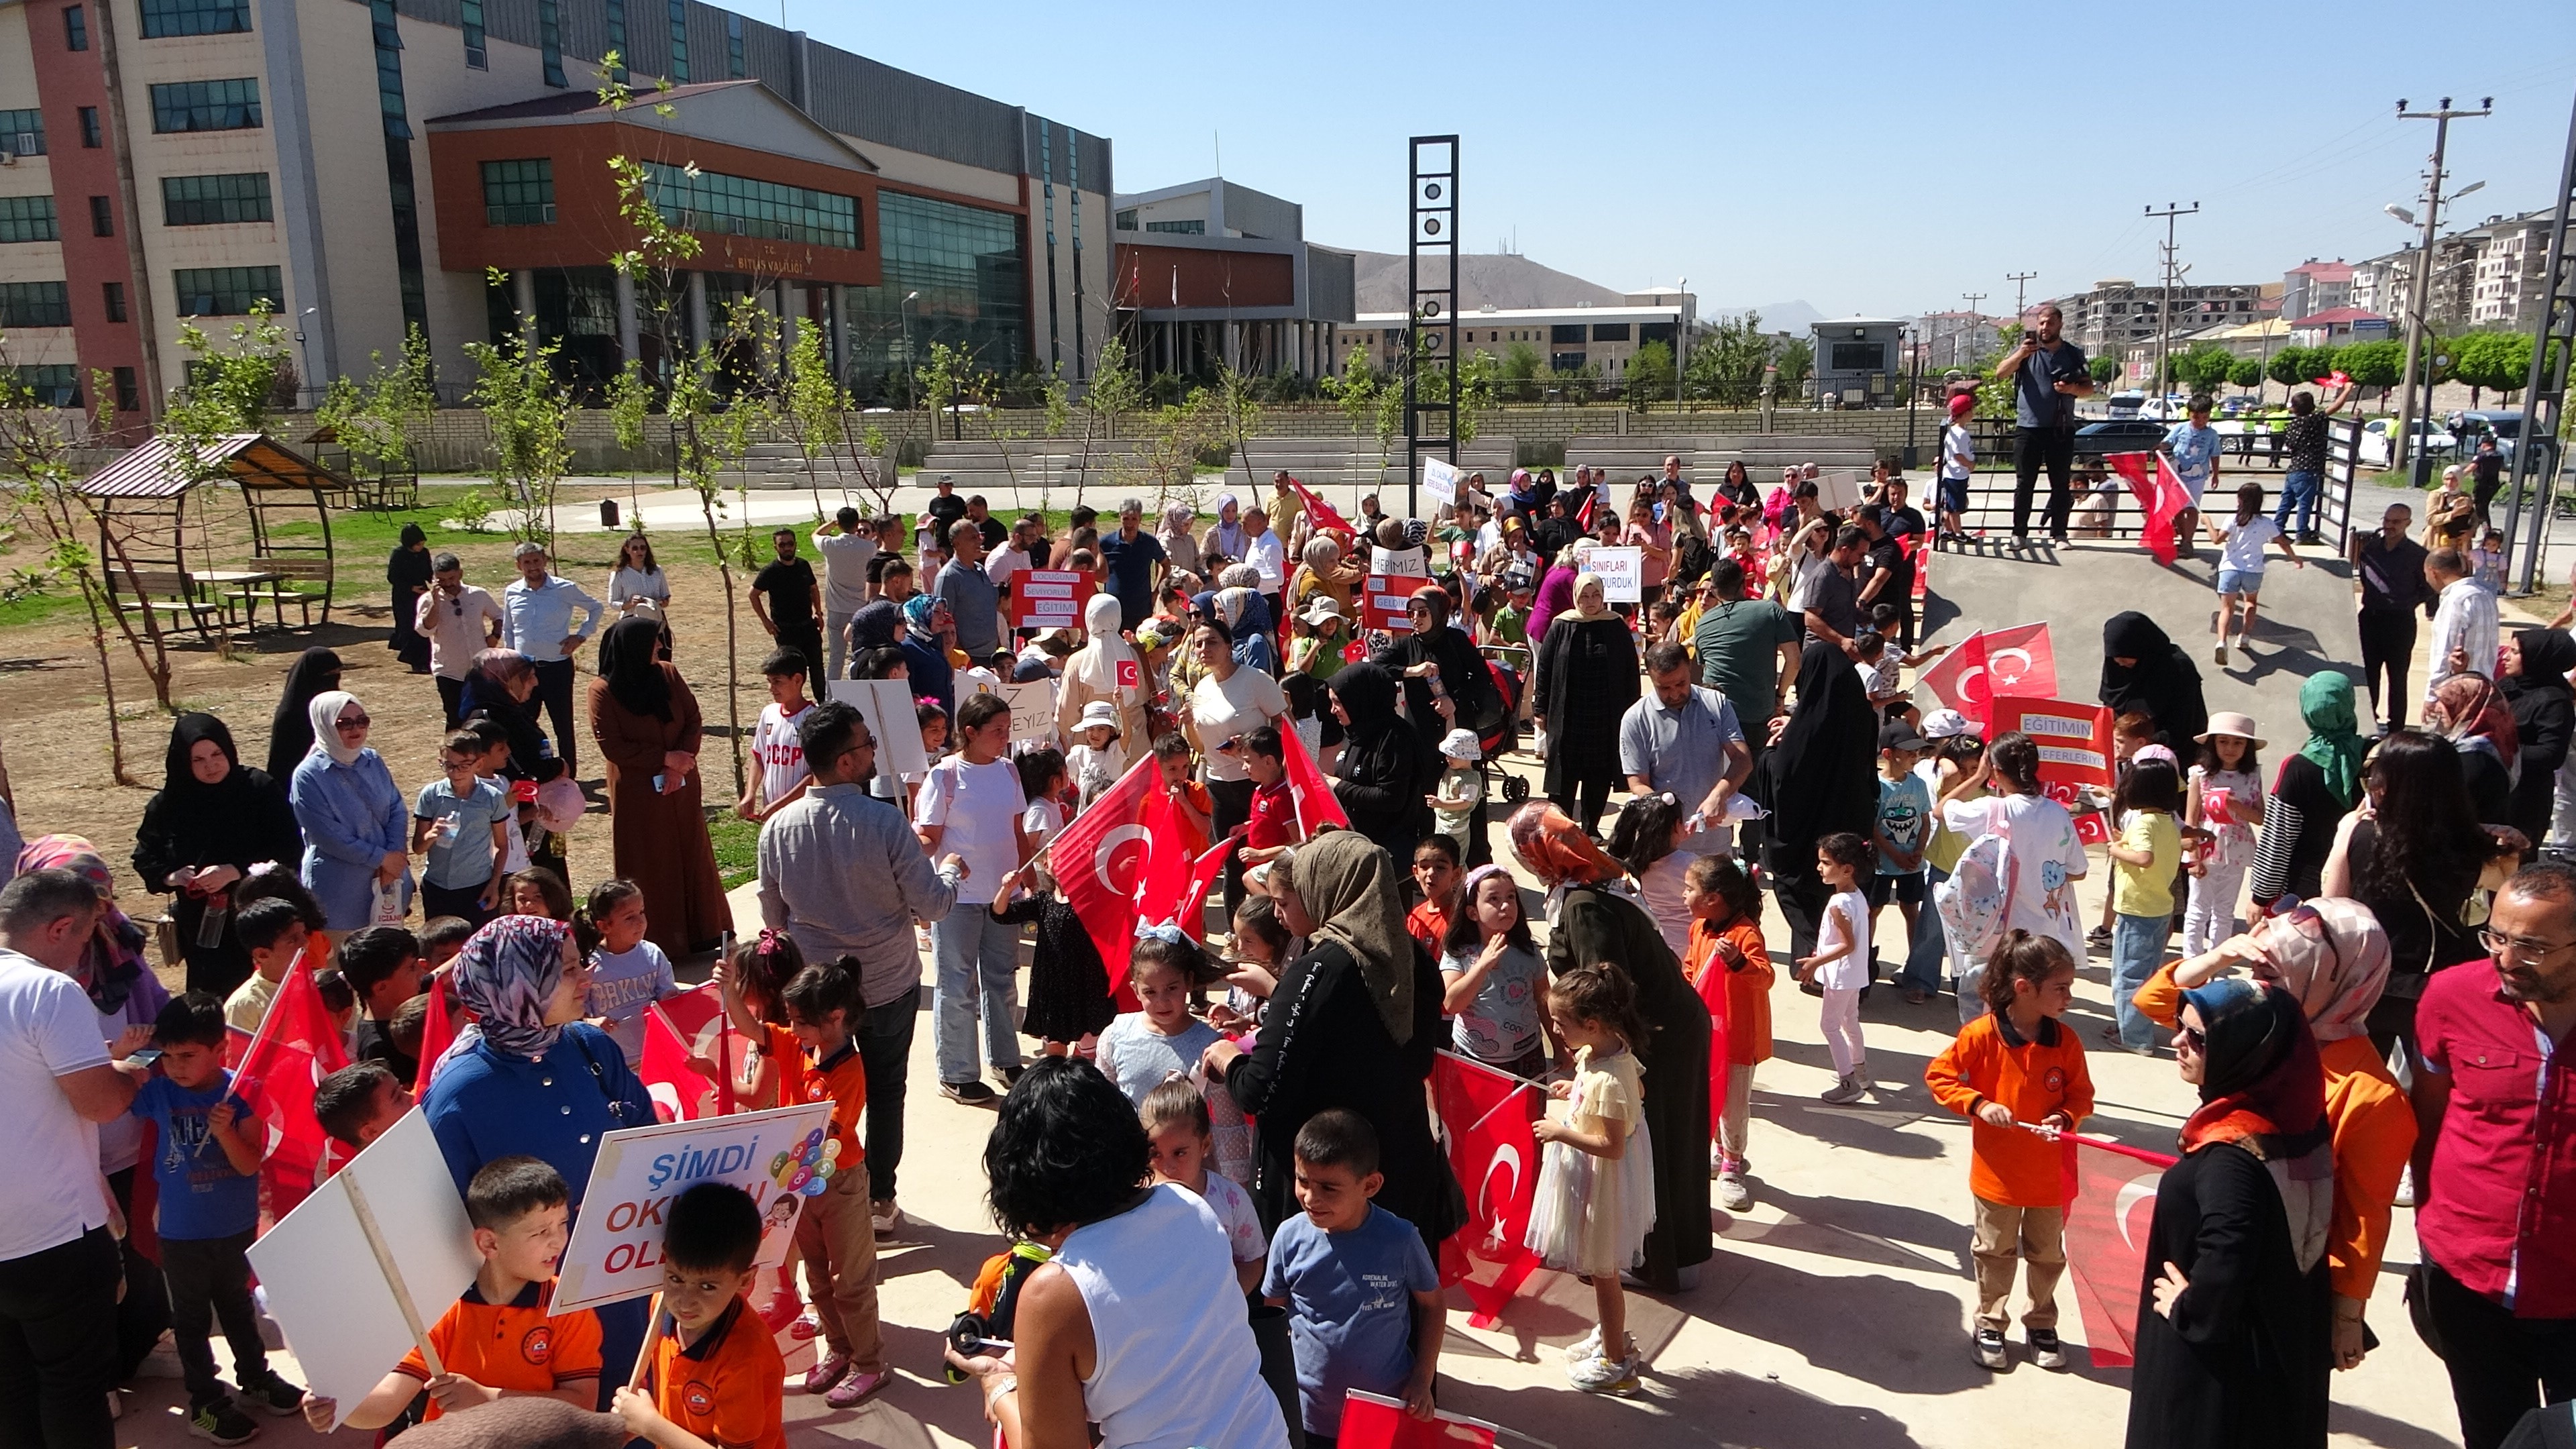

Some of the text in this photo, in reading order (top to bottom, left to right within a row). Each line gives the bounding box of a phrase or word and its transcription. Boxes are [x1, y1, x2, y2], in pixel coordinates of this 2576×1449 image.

[1592, 561, 1627, 572] SINIFLARI
[2024, 716, 2090, 736] EĞİTİMİN
[794, 1146, 803, 1157] 3
[824, 1142, 837, 1154] 2
[648, 1134, 760, 1192] ŞİMDİ
[773, 1158, 782, 1169] 6
[818, 1163, 830, 1173] 5
[794, 1173, 805, 1185] 8
